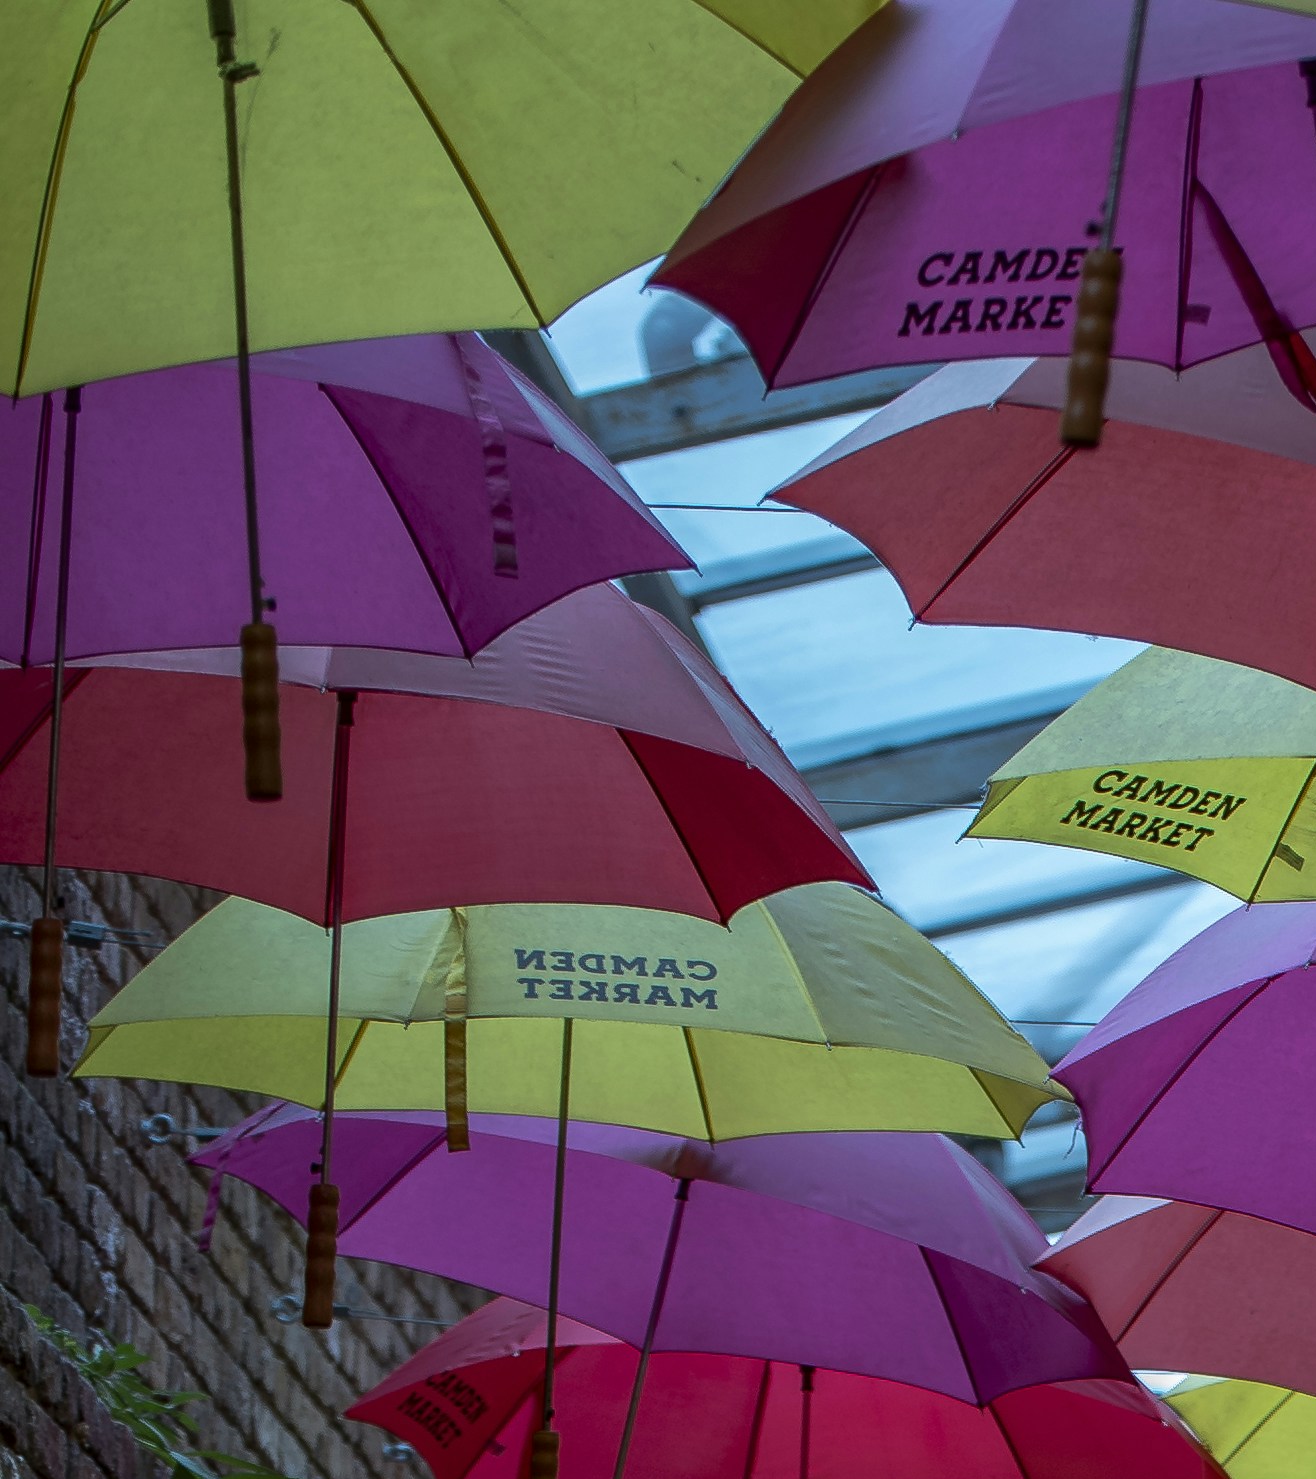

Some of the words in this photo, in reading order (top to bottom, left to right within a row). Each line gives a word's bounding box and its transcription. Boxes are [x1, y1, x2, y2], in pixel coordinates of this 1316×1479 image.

[917, 248, 1088, 288] CAMDE
[898, 295, 1073, 337] MARKE
[1092, 769, 1247, 821] CAMDEN
[1060, 799, 1214, 852] MARKET
